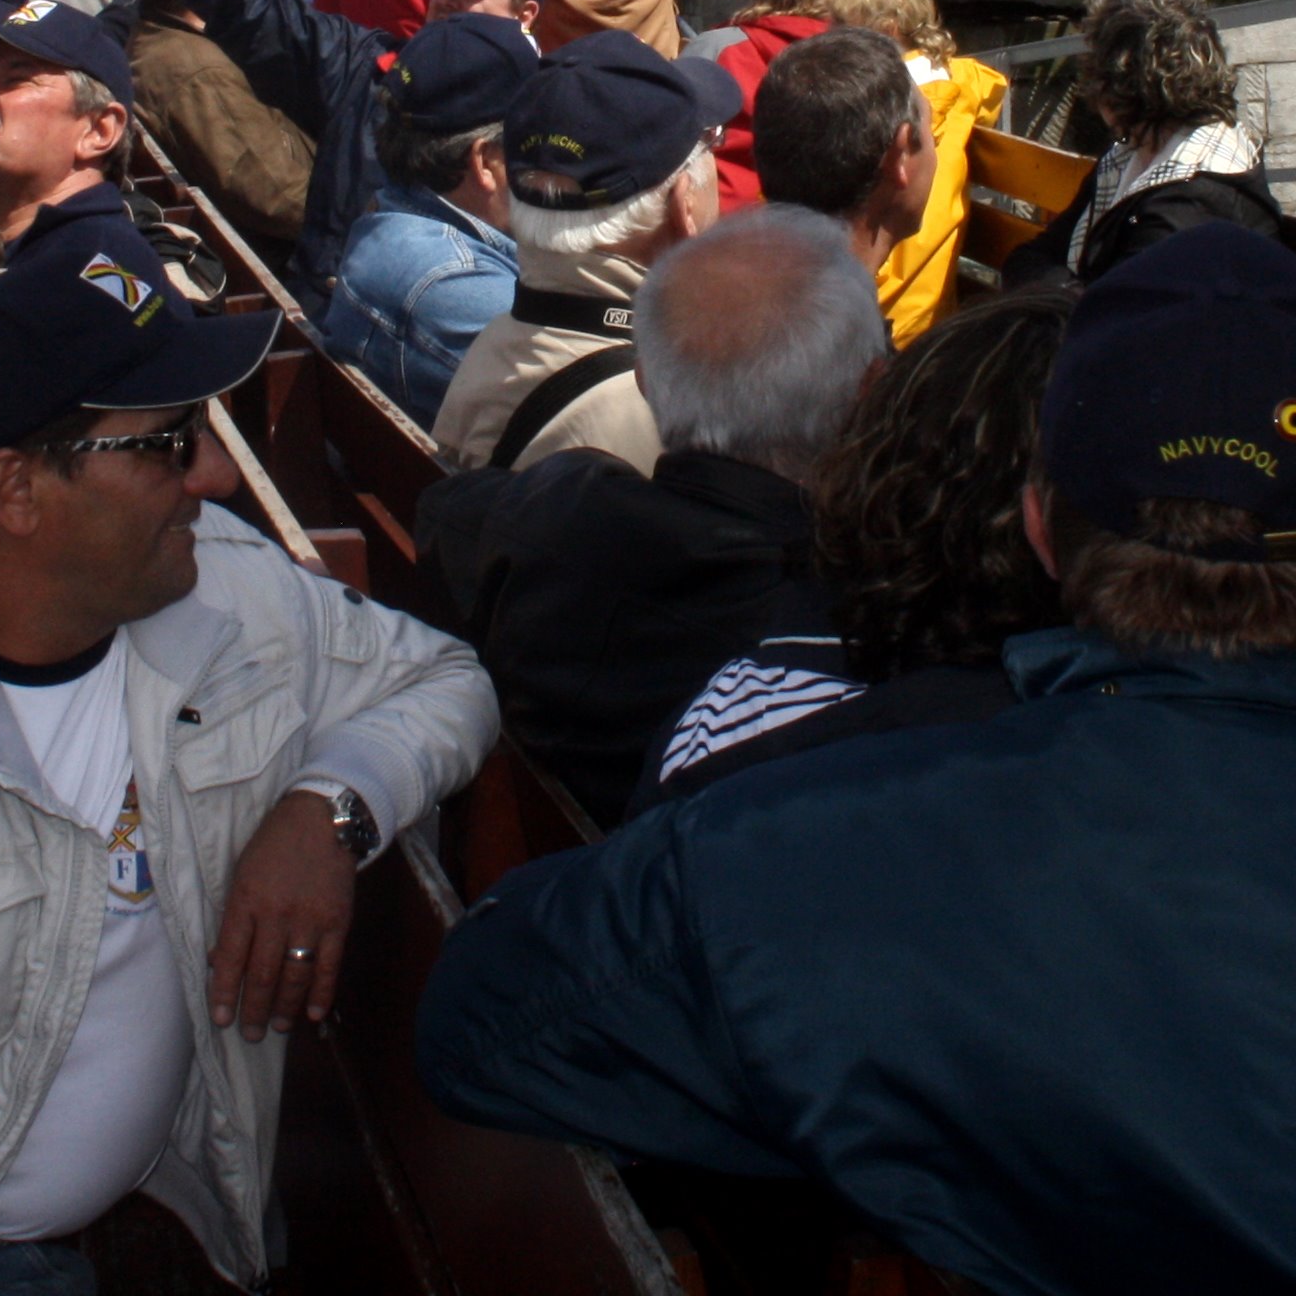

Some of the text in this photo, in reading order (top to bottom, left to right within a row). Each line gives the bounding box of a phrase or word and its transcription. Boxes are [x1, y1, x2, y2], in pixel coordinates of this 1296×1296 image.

[609, 311, 628, 324] USA
[1158, 435, 1280, 478] NAVYCOOL
[117, 858, 133, 880] F
